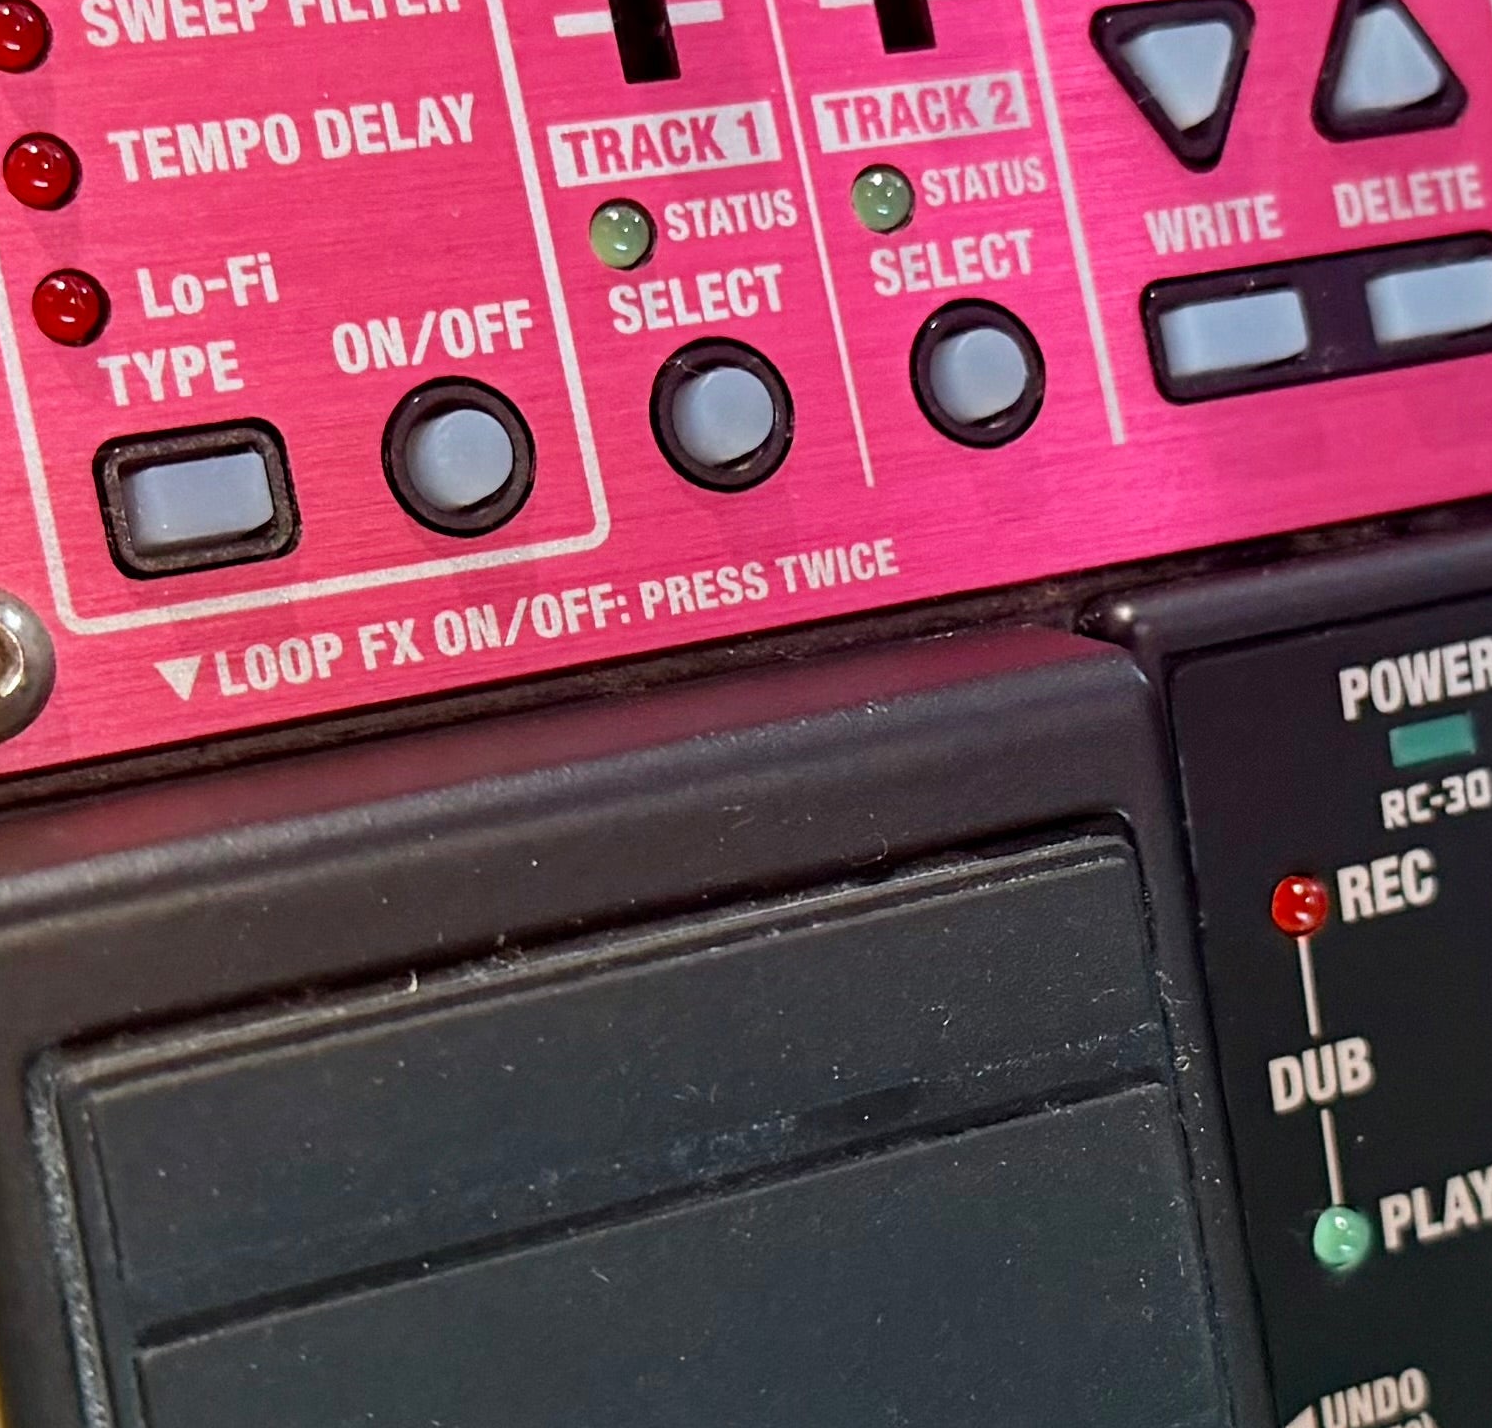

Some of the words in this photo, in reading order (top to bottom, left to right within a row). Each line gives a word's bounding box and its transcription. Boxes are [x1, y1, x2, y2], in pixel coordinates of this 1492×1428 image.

[109, 113, 300, 183] TEMPO
[314, 93, 476, 160] DELAY
[561, 111, 726, 180] TRACK
[737, 108, 760, 157] 1
[823, 80, 980, 147] TRACK
[988, 78, 1021, 128] 2
[664, 189, 798, 242] STATUS
[924, 156, 1048, 208] STATUS
[1332, 167, 1484, 231] DELETE
[1145, 193, 1283, 258] WRITE
[136, 252, 280, 319] Lo-Fi
[870, 230, 1034, 298] SELECT
[609, 264, 784, 335] SELECT
[332, 298, 534, 375] ON/OFF
[99, 340, 245, 407] TYPE
[215, 632, 344, 698] LOOP
[360, 618, 420, 672] FX
[435, 582, 630, 657] ON/OFF:
[641, 561, 769, 620] PRESS
[776, 538, 900, 595] TWICE
[1337, 848, 1438, 923] REC
[1268, 1036, 1374, 1114] DUB
